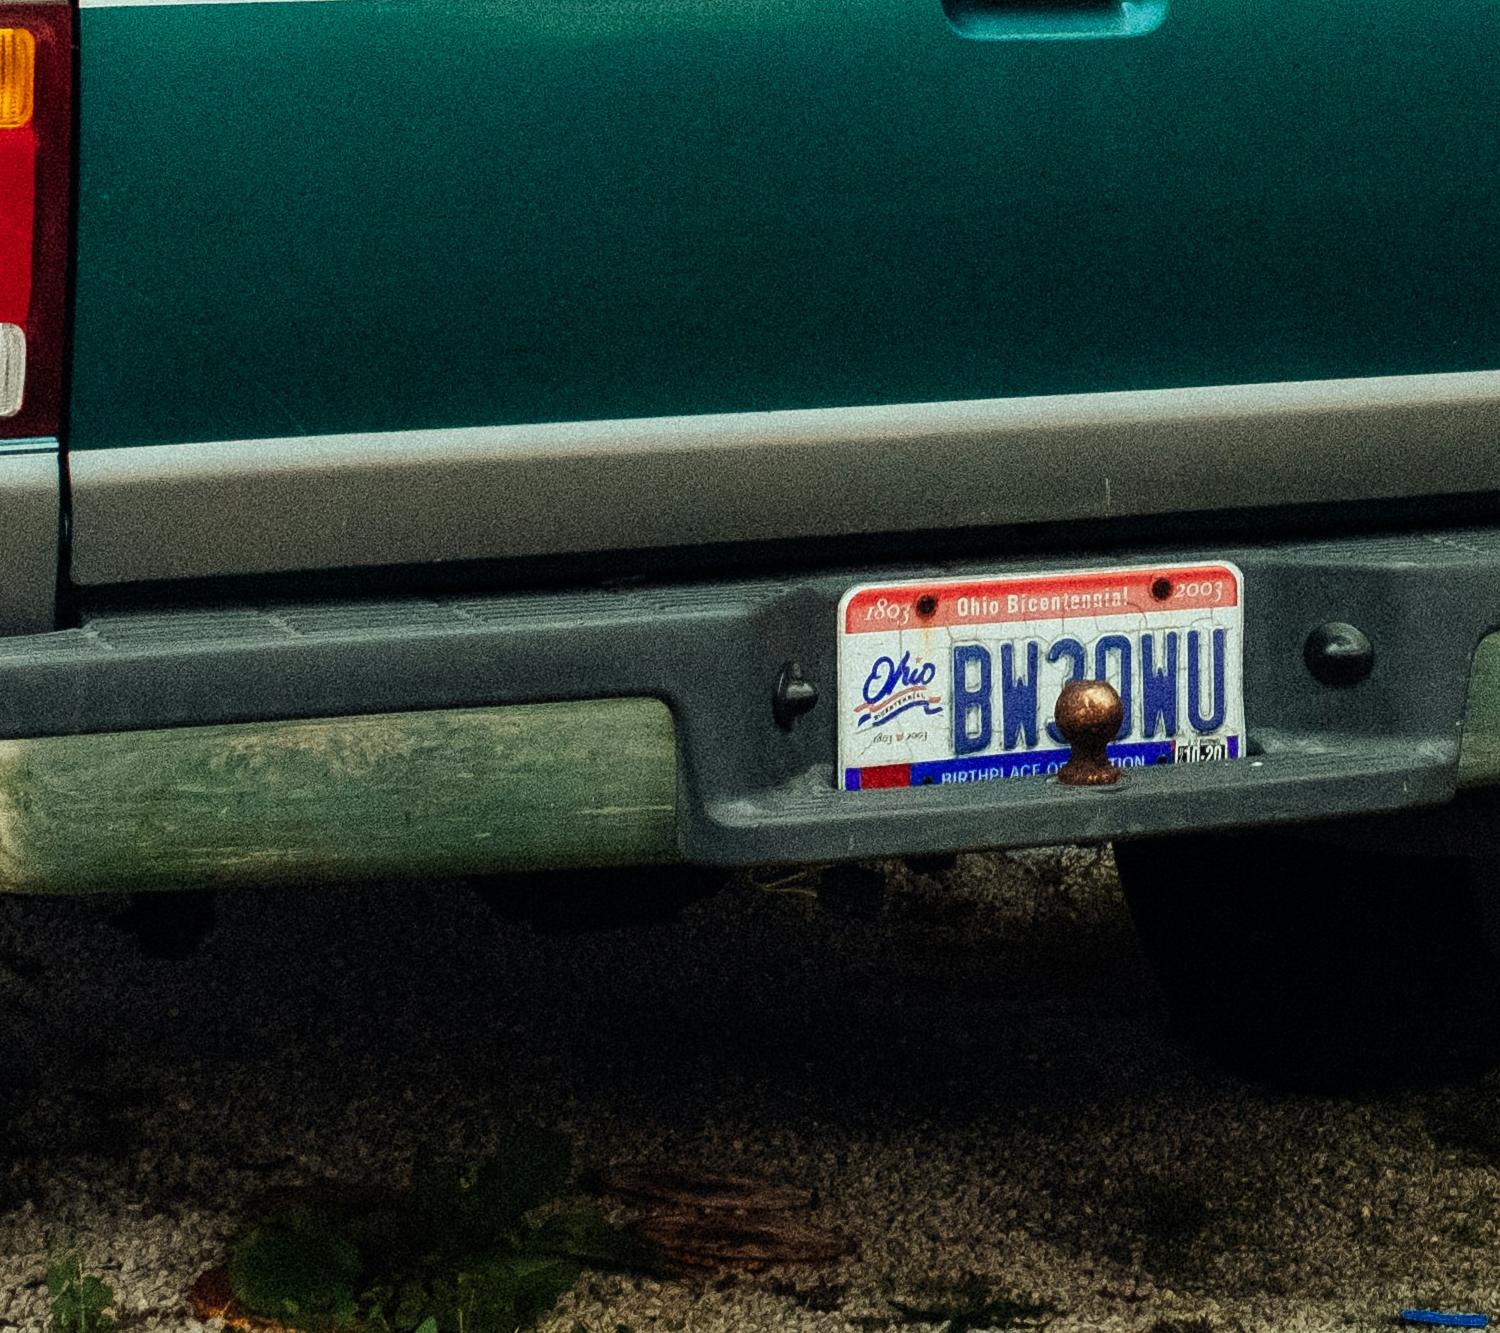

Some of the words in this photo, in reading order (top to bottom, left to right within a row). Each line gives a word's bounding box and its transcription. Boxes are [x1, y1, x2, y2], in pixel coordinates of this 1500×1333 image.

[865, 598, 912, 625] 1803
[957, 596, 999, 617] Ohio
[1174, 581, 1223, 603] 2003
[862, 650, 937, 705] Ohio
